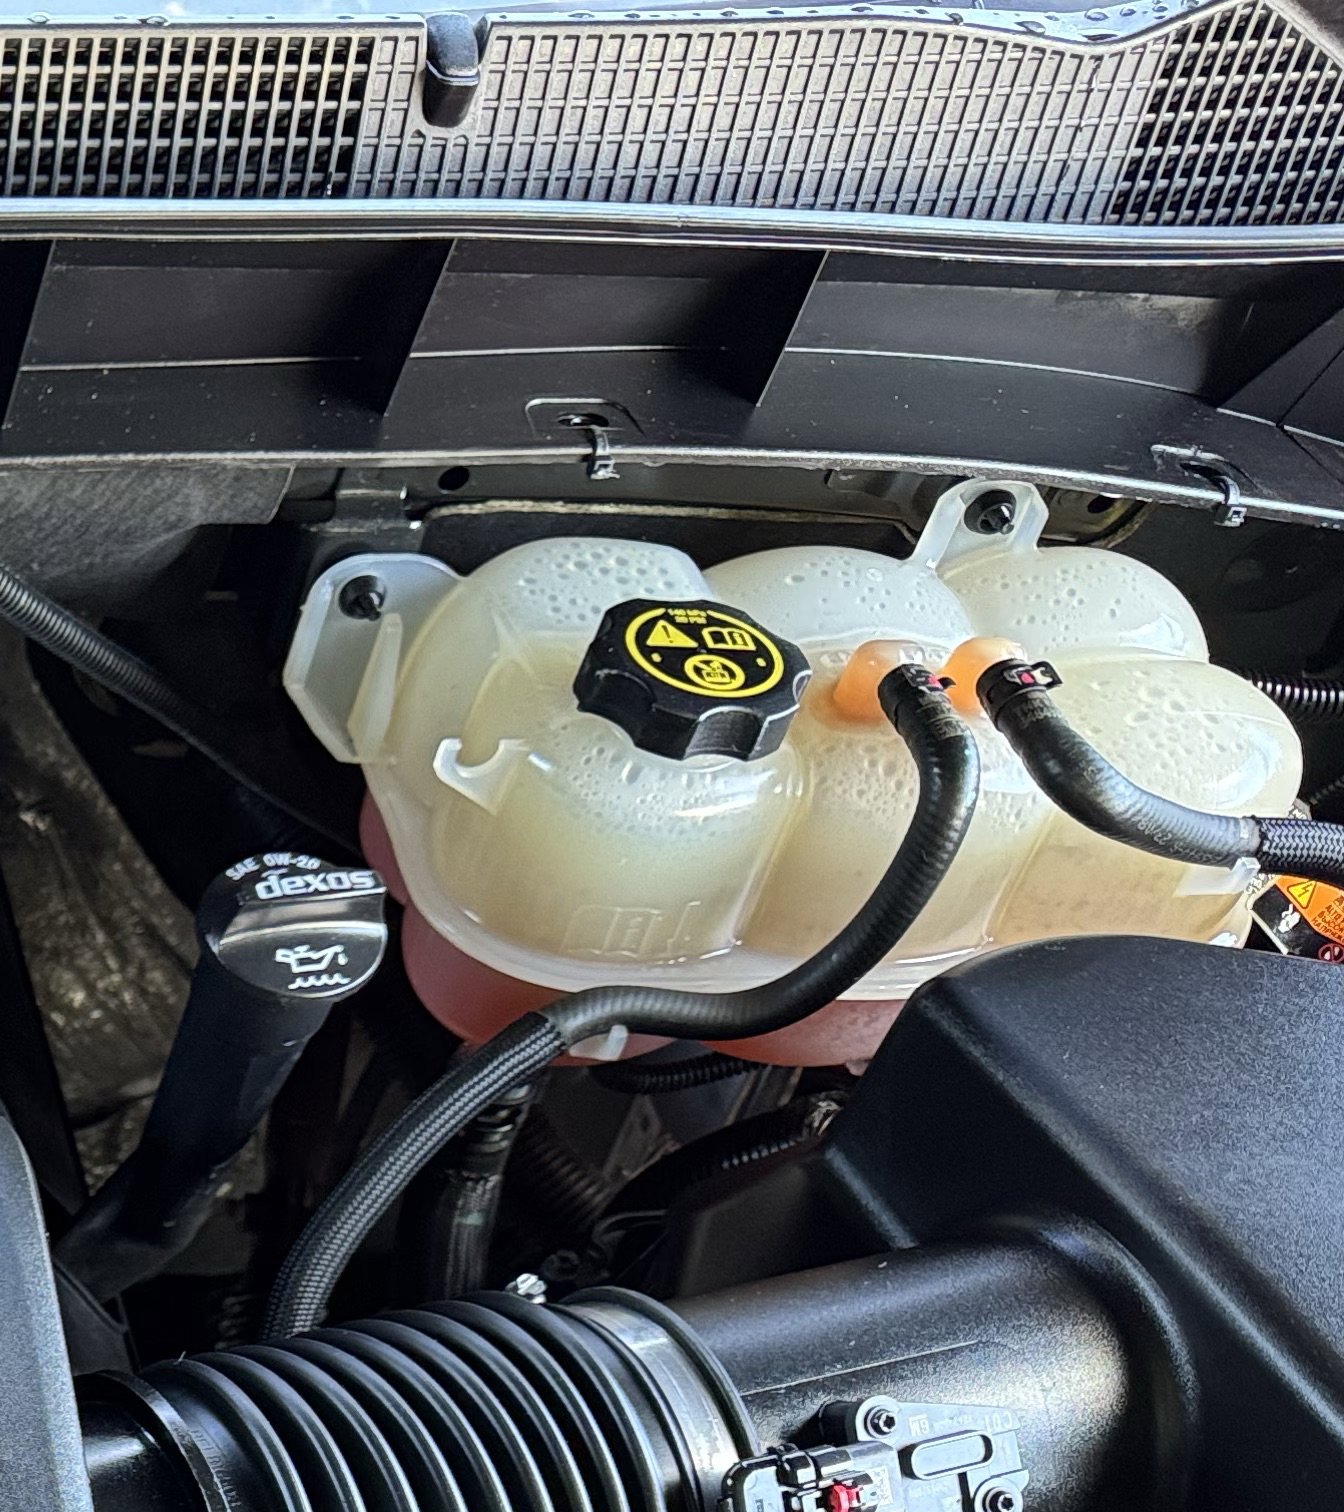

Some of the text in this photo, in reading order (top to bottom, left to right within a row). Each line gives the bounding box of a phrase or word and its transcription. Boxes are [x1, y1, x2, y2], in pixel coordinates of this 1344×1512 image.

[225, 852, 321, 881] SAE 0W-20
[255, 870, 377, 900] dexos
